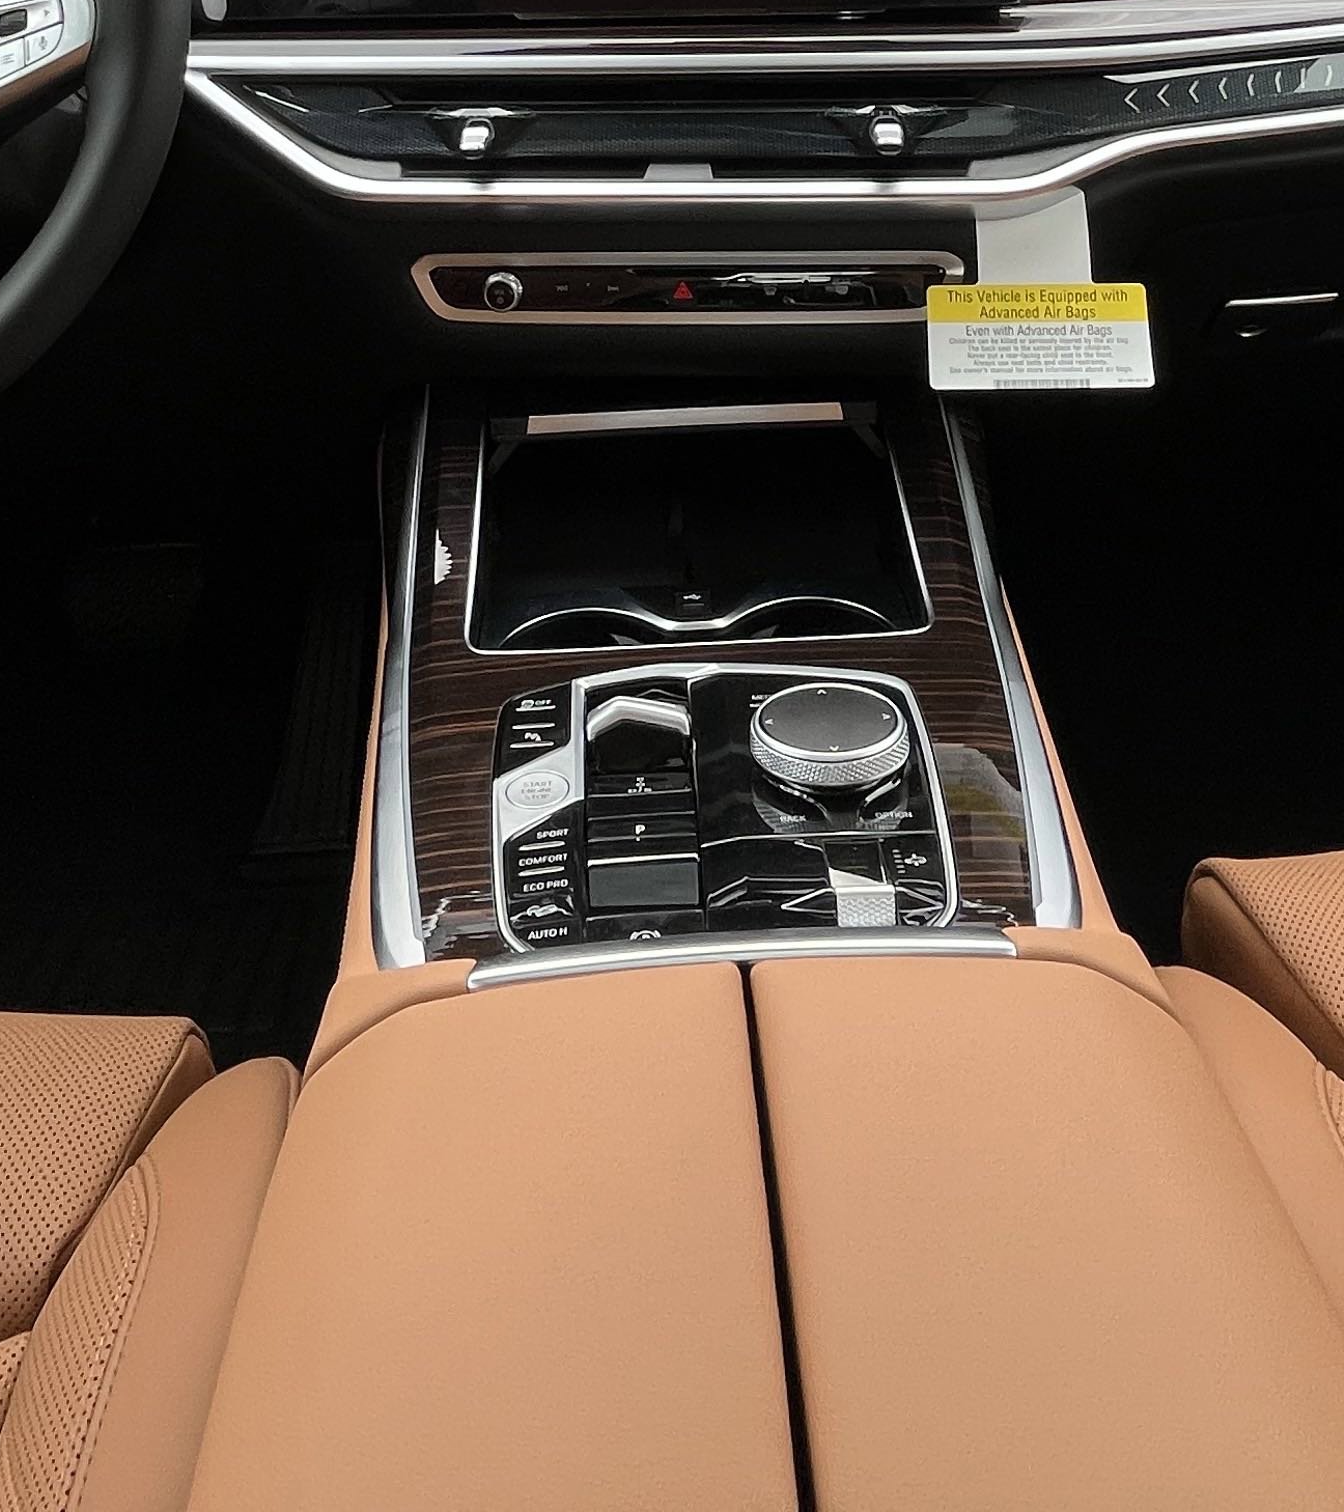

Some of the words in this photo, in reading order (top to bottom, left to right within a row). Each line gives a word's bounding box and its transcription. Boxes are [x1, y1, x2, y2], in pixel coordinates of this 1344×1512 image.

[948, 290, 973, 304] This
[977, 289, 1021, 303] Vehicle
[1025, 289, 1036, 303] is
[1040, 289, 1097, 304] Equipped
[1101, 289, 1128, 302] with
[980, 305, 1040, 319] Advanced
[1044, 305, 1061, 318] Air
[1065, 305, 1096, 320] Bags
[965, 325, 990, 336] Even
[993, 325, 1014, 336] with
[1017, 324, 1066, 336] Advanced
[1070, 324, 1084, 335] Air
[1087, 324, 1112, 337] Bags
[874, 811, 914, 819] OPTION
[536, 828, 569, 840] SPORT
[635, 825, 646, 835] P
[518, 852, 568, 867] COMFORT
[523, 882, 545, 893] ECO
[546, 879, 569, 889] PRO
[527, 928, 558, 940] AUTO
[559, 926, 568, 936] H
